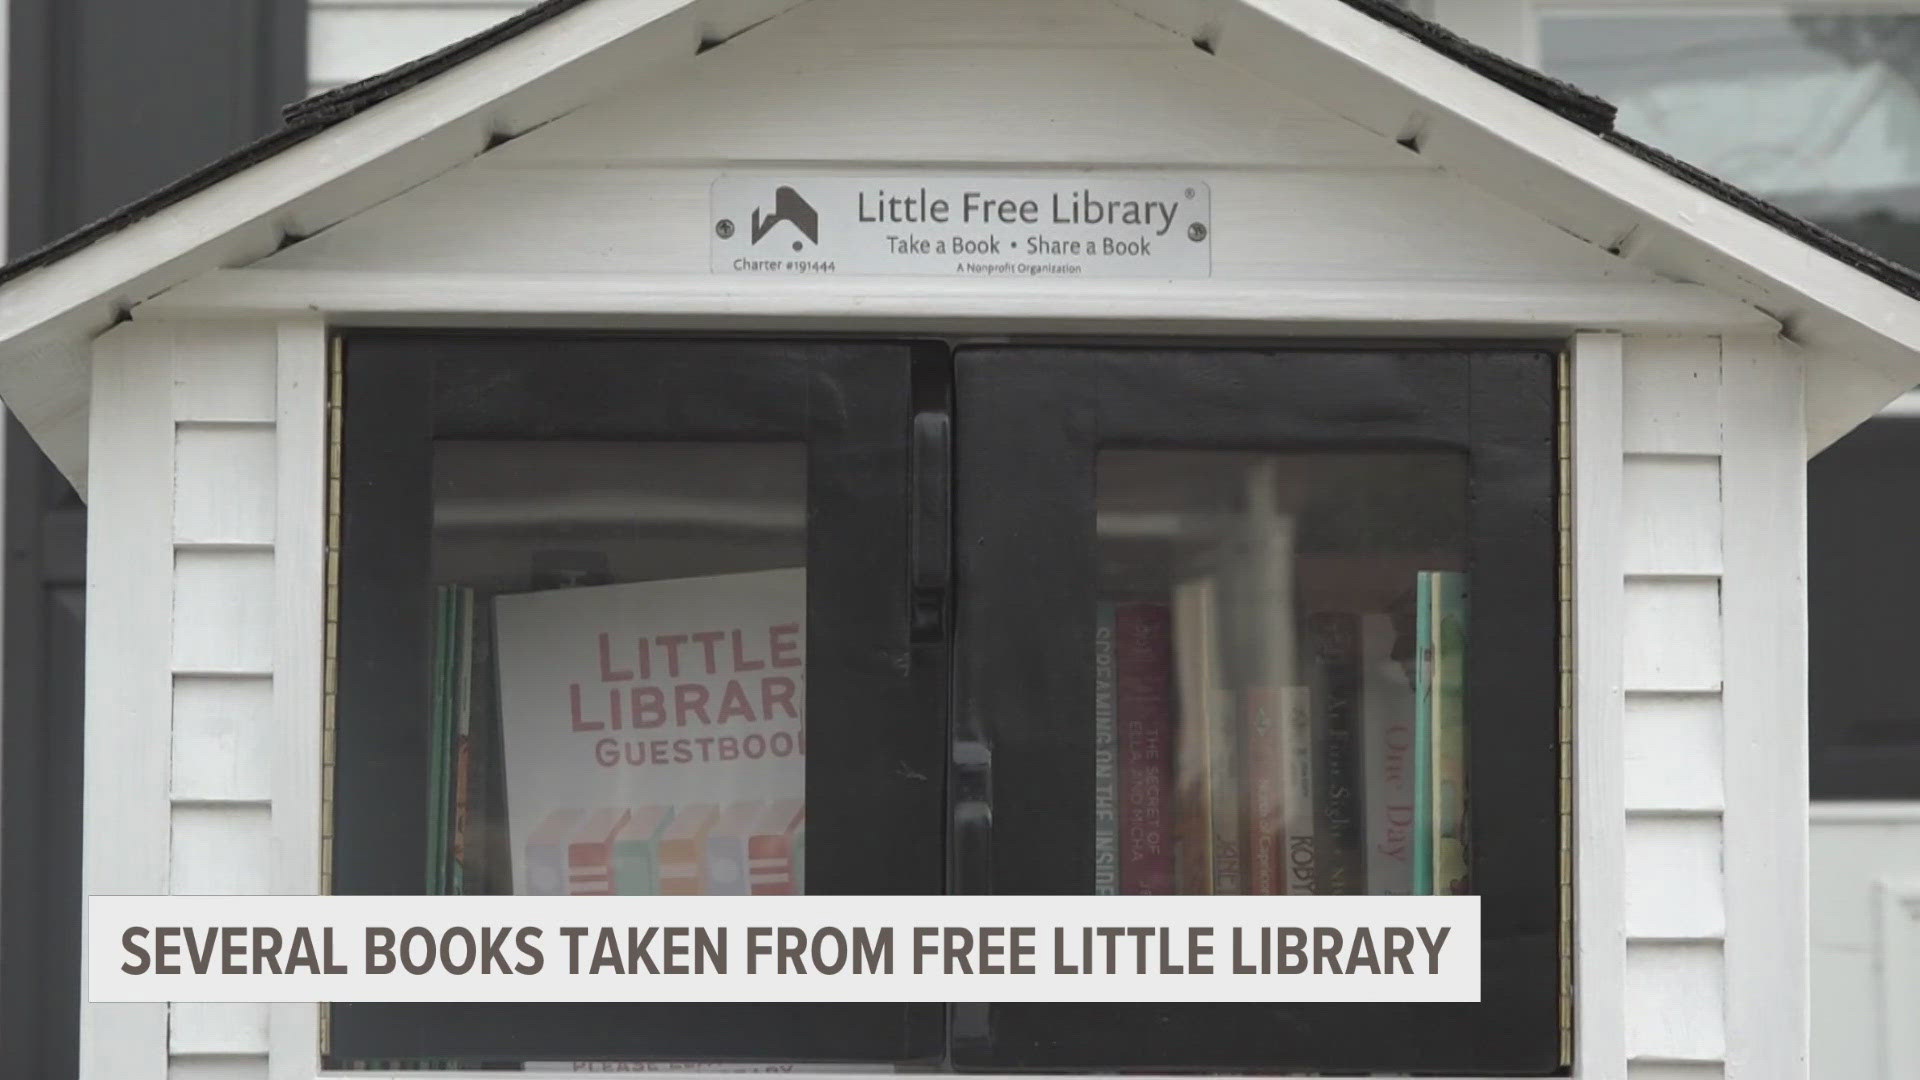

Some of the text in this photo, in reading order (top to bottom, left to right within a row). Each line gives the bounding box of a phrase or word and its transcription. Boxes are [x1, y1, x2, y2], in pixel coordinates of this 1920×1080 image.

[858, 188, 949, 224] Little
[962, 191, 1039, 224] Free
[1052, 189, 1179, 236] Library
[733, 257, 836, 274] Charter #191444
[887, 235, 1151, 256] Take a Book Share a Book
[956, 262, 1082, 276] A Nonprofit Organization
[598, 622, 803, 683] LITTLE
[570, 676, 806, 732] LIBRAR
[1095, 626, 1113, 744] SCREAMING
[1095, 750, 1113, 778] ON
[1096, 784, 1113, 821] THE
[1128, 720, 1144, 863] ELLA AND MICHA
[1145, 728, 1161, 856] THE SECRET OF
[1377, 724, 1414, 863] One Day
